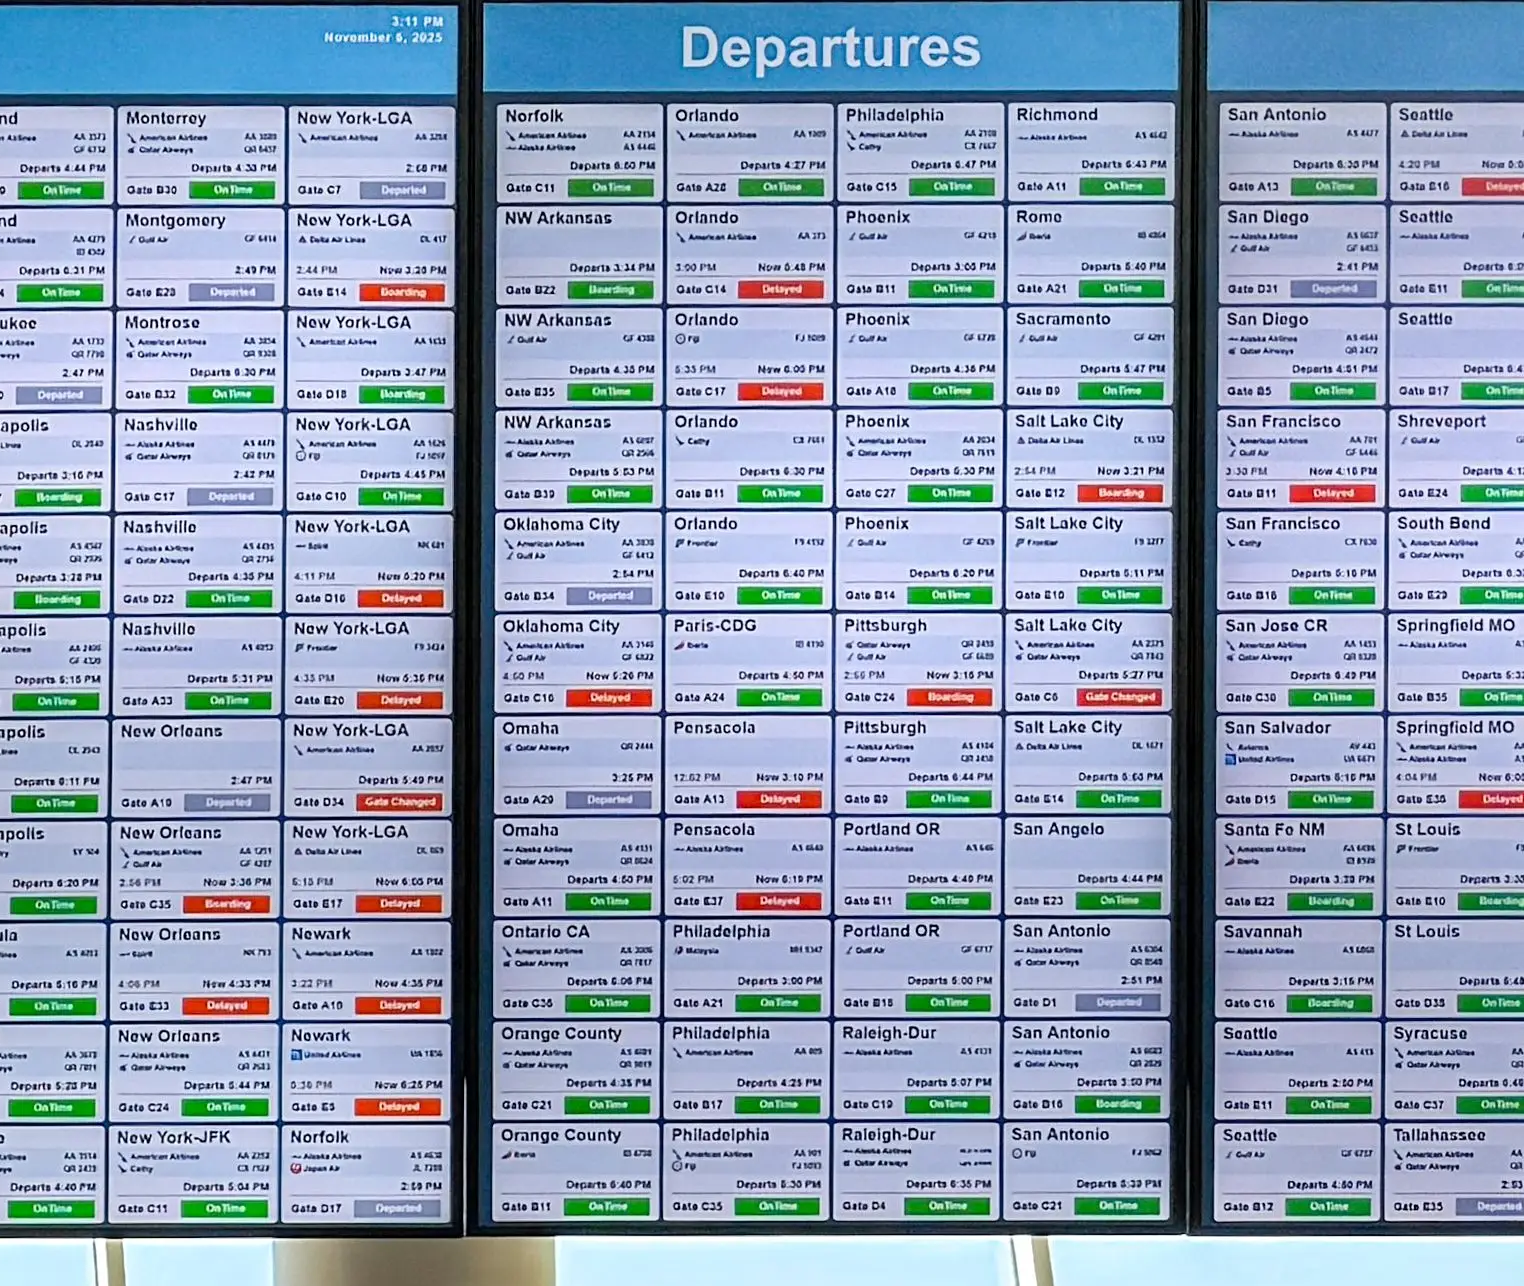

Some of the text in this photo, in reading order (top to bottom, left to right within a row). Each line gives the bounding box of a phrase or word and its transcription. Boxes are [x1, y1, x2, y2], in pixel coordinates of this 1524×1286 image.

[392, 16, 443, 27] 3:11 PM
[325, 33, 391, 43] November
[412, 32, 442, 43] 2025
[684, 27, 980, 77] Departures
[1018, 108, 1097, 120] Richmond
[1229, 108, 1326, 121] San Antonio
[126, 214, 225, 229] Montgomery
[1228, 210, 1308, 226] San Diego
[505, 313, 611, 326] NW Arkansas
[846, 312, 909, 325] Phoenix
[1017, 313, 1110, 325] Sacramento
[125, 418, 197, 431] Nashville
[1227, 415, 1340, 427] San Francisco
[1398, 415, 1486, 430] Shreveport
[296, 520, 410, 533] New York-LGA
[675, 517, 737, 530] Orlando
[739, 569, 780, 579] Departs
[807, 569, 824, 577] PM
[675, 619, 756, 632] Paris-CDG
[845, 619, 926, 634] Pittsburgh
[675, 693, 725, 702] Gate A24
[1225, 721, 1331, 734] San Salvador
[503, 824, 558, 836] Omaha
[674, 823, 754, 835] Pensacola
[844, 823, 939, 835] Portland OR
[1014, 822, 1104, 838] San Angelo
[1396, 823, 1460, 835] St Louis
[1078, 874, 1118, 884] Departs
[1146, 875, 1163, 883] PM
[292, 927, 350, 940] Newark
[674, 925, 770, 940] Philadelphia
[1224, 925, 1302, 938] Savannah
[1394, 1027, 1467, 1042] Syracuse
[118, 1130, 230, 1144] New York-JFK
[291, 1131, 348, 1143] Norfolk
[502, 1129, 621, 1144] Orange County
[843, 1128, 935, 1143] Raleigh-Dur
[1394, 1128, 1485, 1141] Tallahassee
